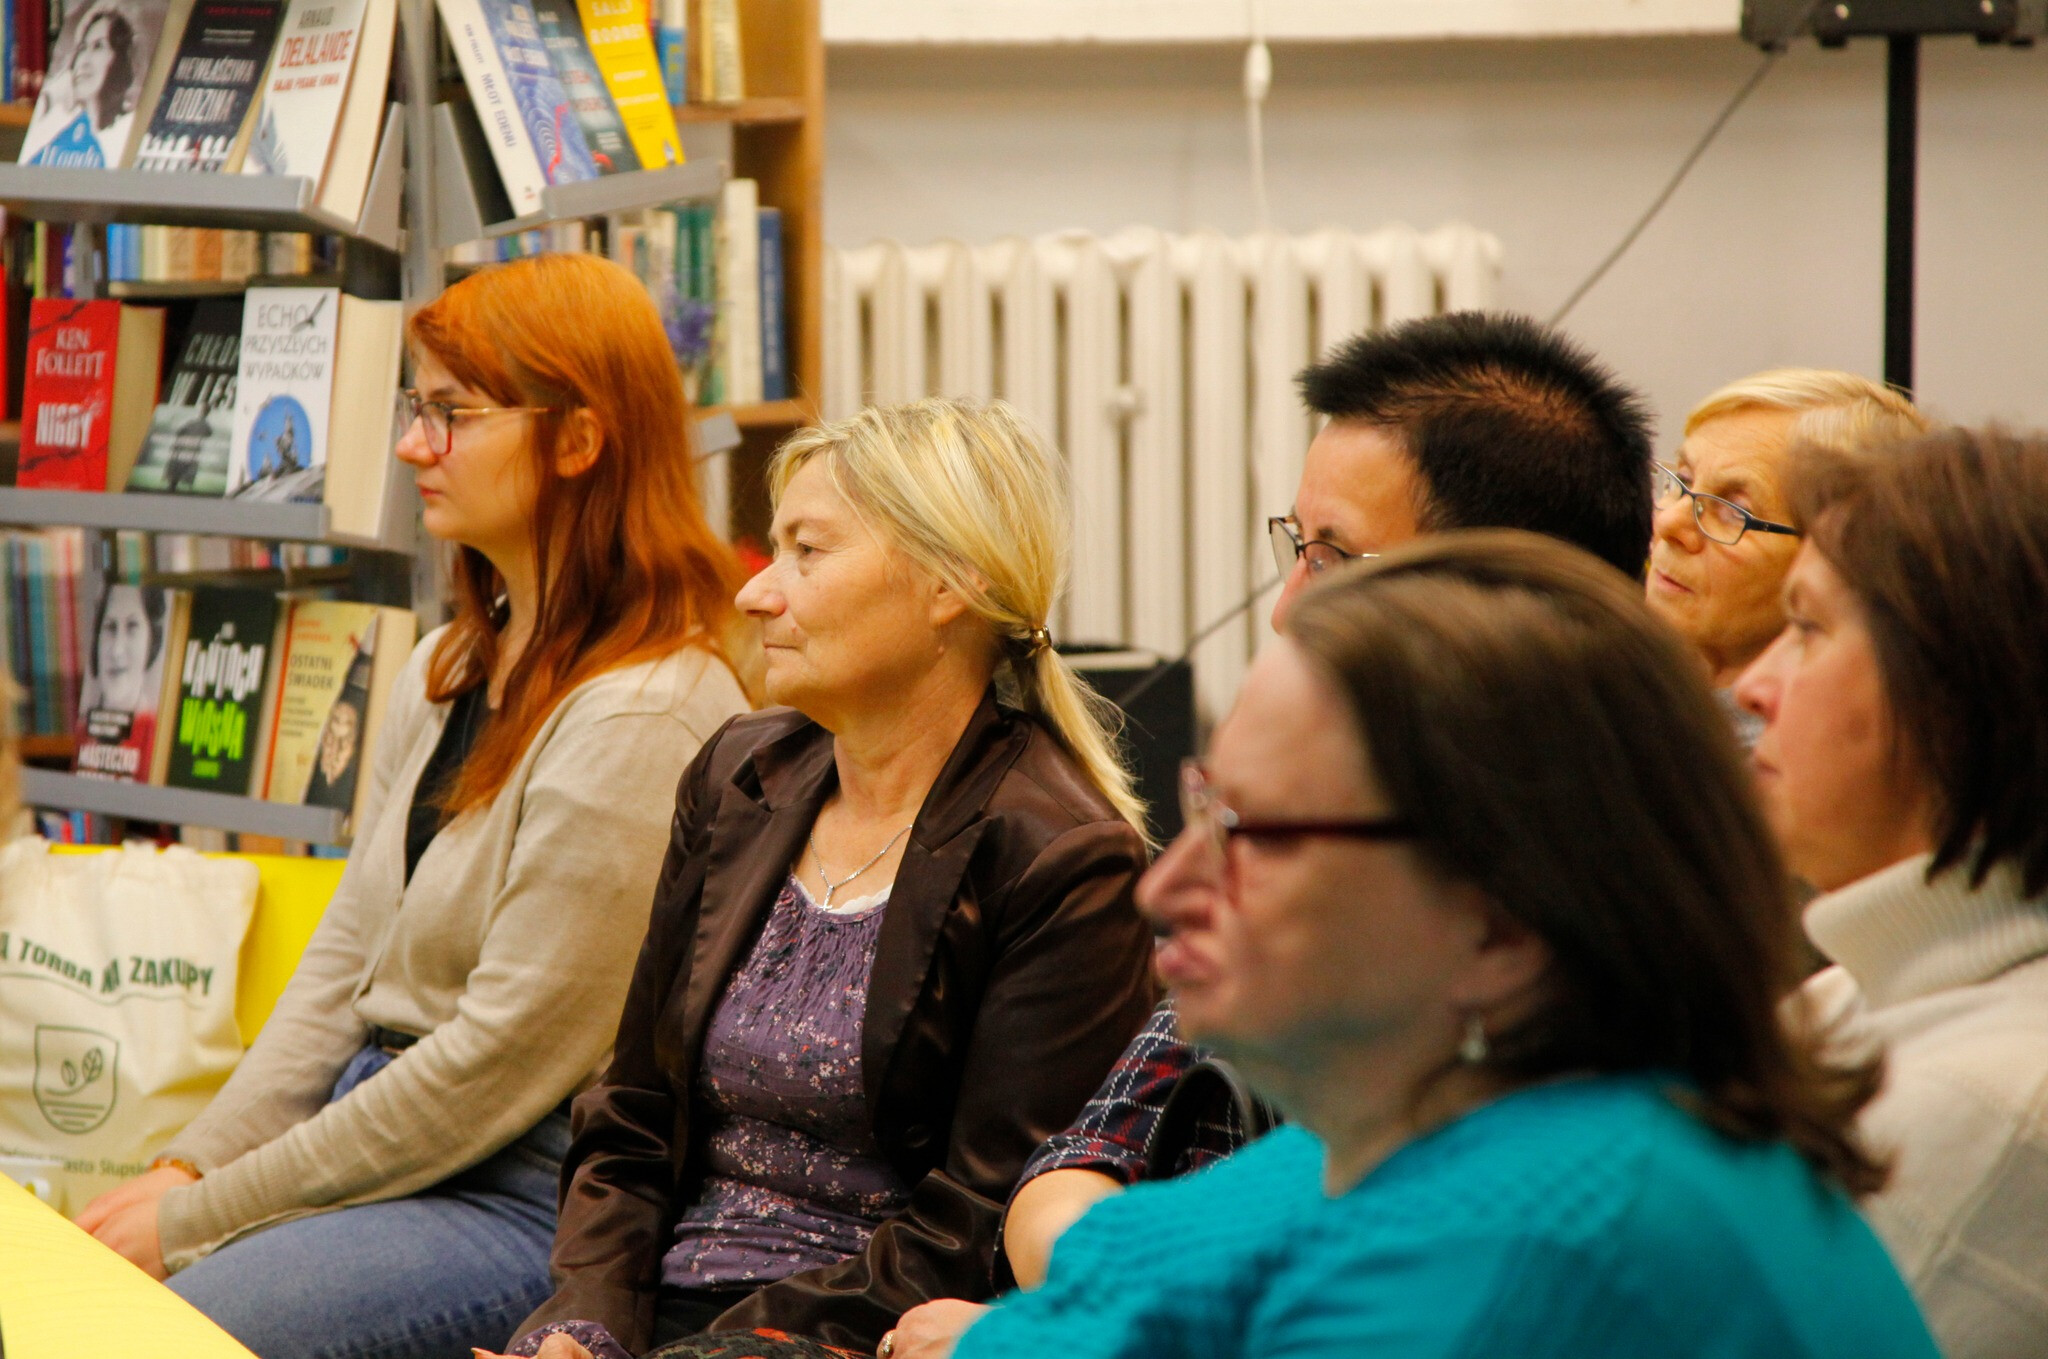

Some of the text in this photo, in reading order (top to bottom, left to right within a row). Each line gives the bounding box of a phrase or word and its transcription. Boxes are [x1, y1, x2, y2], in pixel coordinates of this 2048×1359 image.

[279, 29, 353, 68] DELALANDE
[165, 86, 238, 122] RODZINA
[481, 72, 518, 148] MŁOT EDENU
[257, 303, 309, 329] ECHO
[56, 327, 92, 349] KEN
[245, 334, 328, 356] PRZYSZŁYCH
[36, 348, 106, 378] FOLLETT
[245, 360, 325, 381] WYPADKÓW
[290, 654, 333, 670] OSTATNI
[129, 956, 214, 996] ZAKUPY
